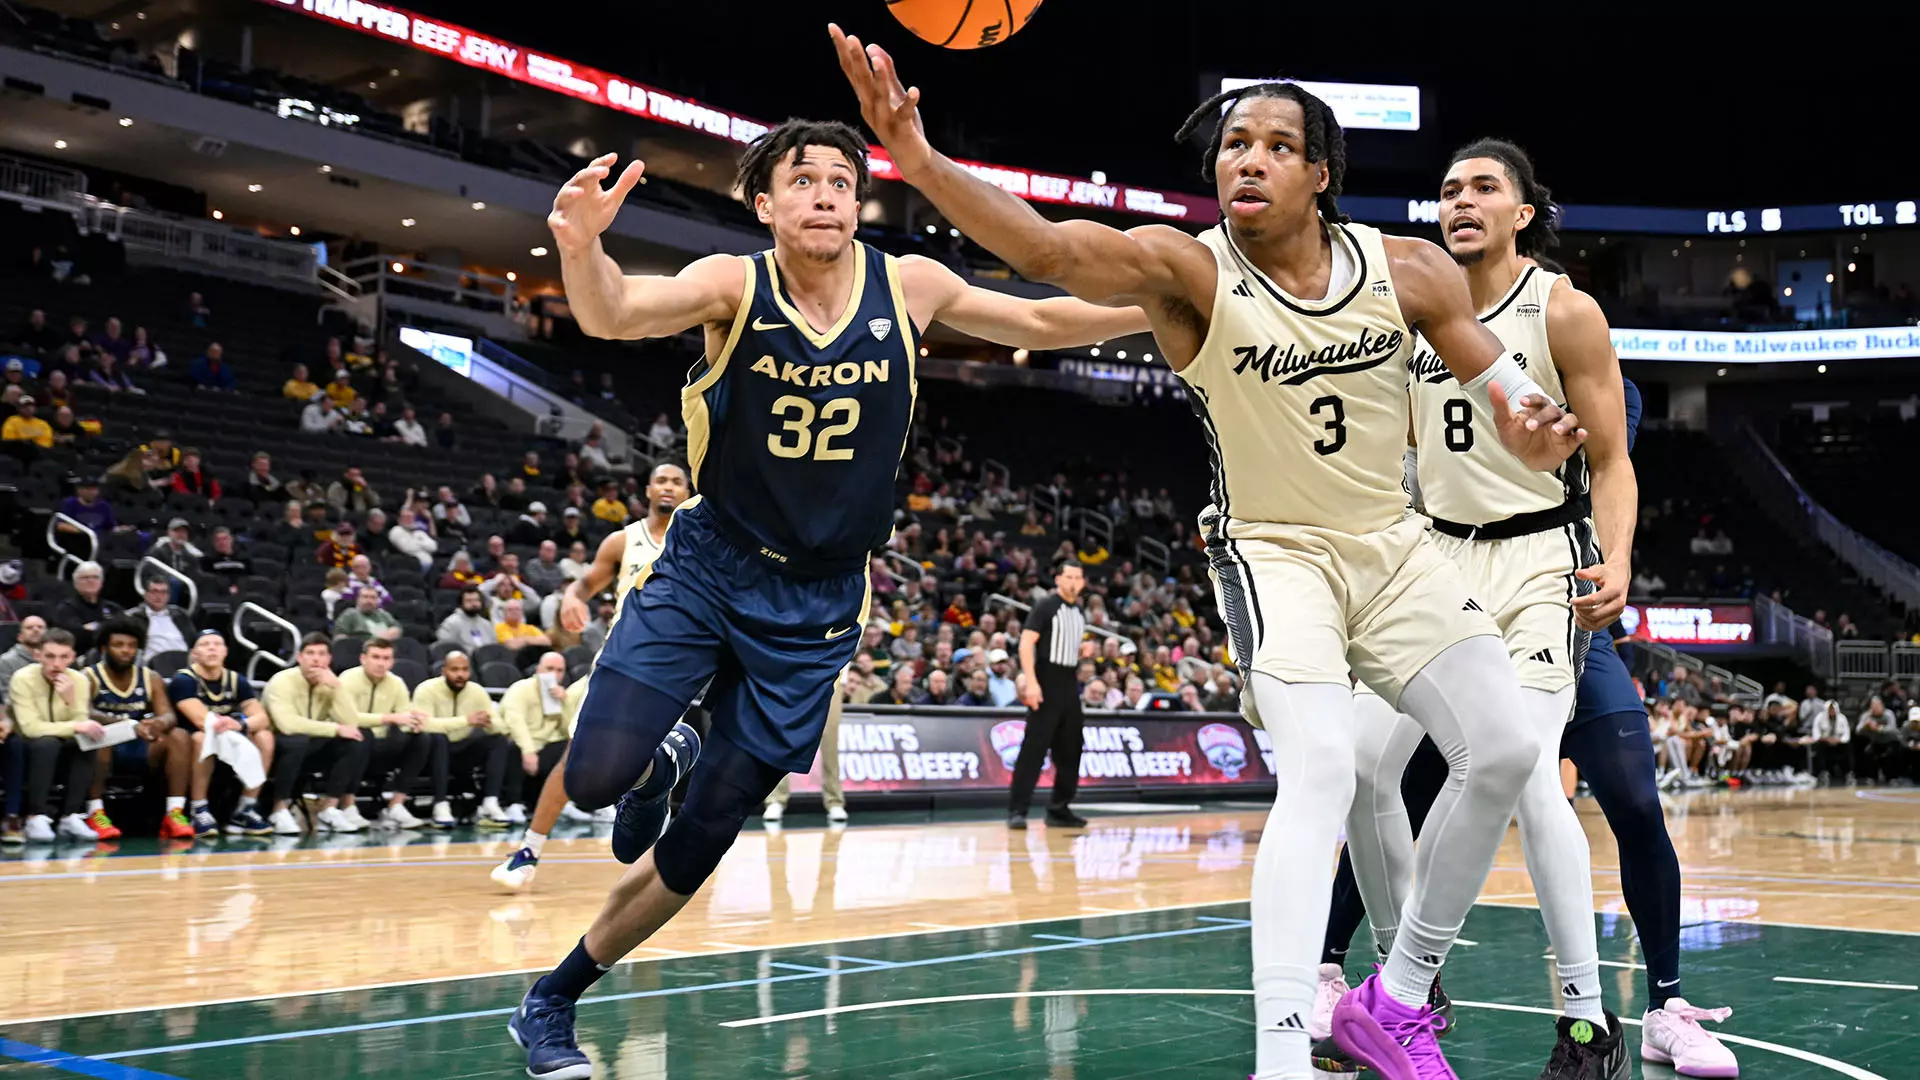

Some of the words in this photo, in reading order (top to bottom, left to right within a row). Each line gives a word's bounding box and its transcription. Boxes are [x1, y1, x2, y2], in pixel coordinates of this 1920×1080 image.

[411, 18, 461, 54] BEEF
[459, 34, 518, 71] JERKY
[1707, 211, 1747, 233] FLS
[1839, 204, 1884, 226] TOL
[1232, 327, 1403, 386] Milwaukee
[1611, 336, 1660, 351] vider
[1668, 336, 1687, 351] of
[1694, 338, 1727, 353] the
[1733, 335, 1858, 354] Milwaukee
[1864, 332, 1920, 350] Buck
[750, 354, 890, 388] AKRON
[767, 394, 861, 461] 32
[1309, 395, 1347, 456] 3
[1443, 398, 1475, 453] 8
[760, 546, 788, 563] ZIPS
[1082, 726, 1144, 751] HAT'S
[902, 752, 979, 779] BEEF?
[1130, 752, 1191, 776] BEEF?
